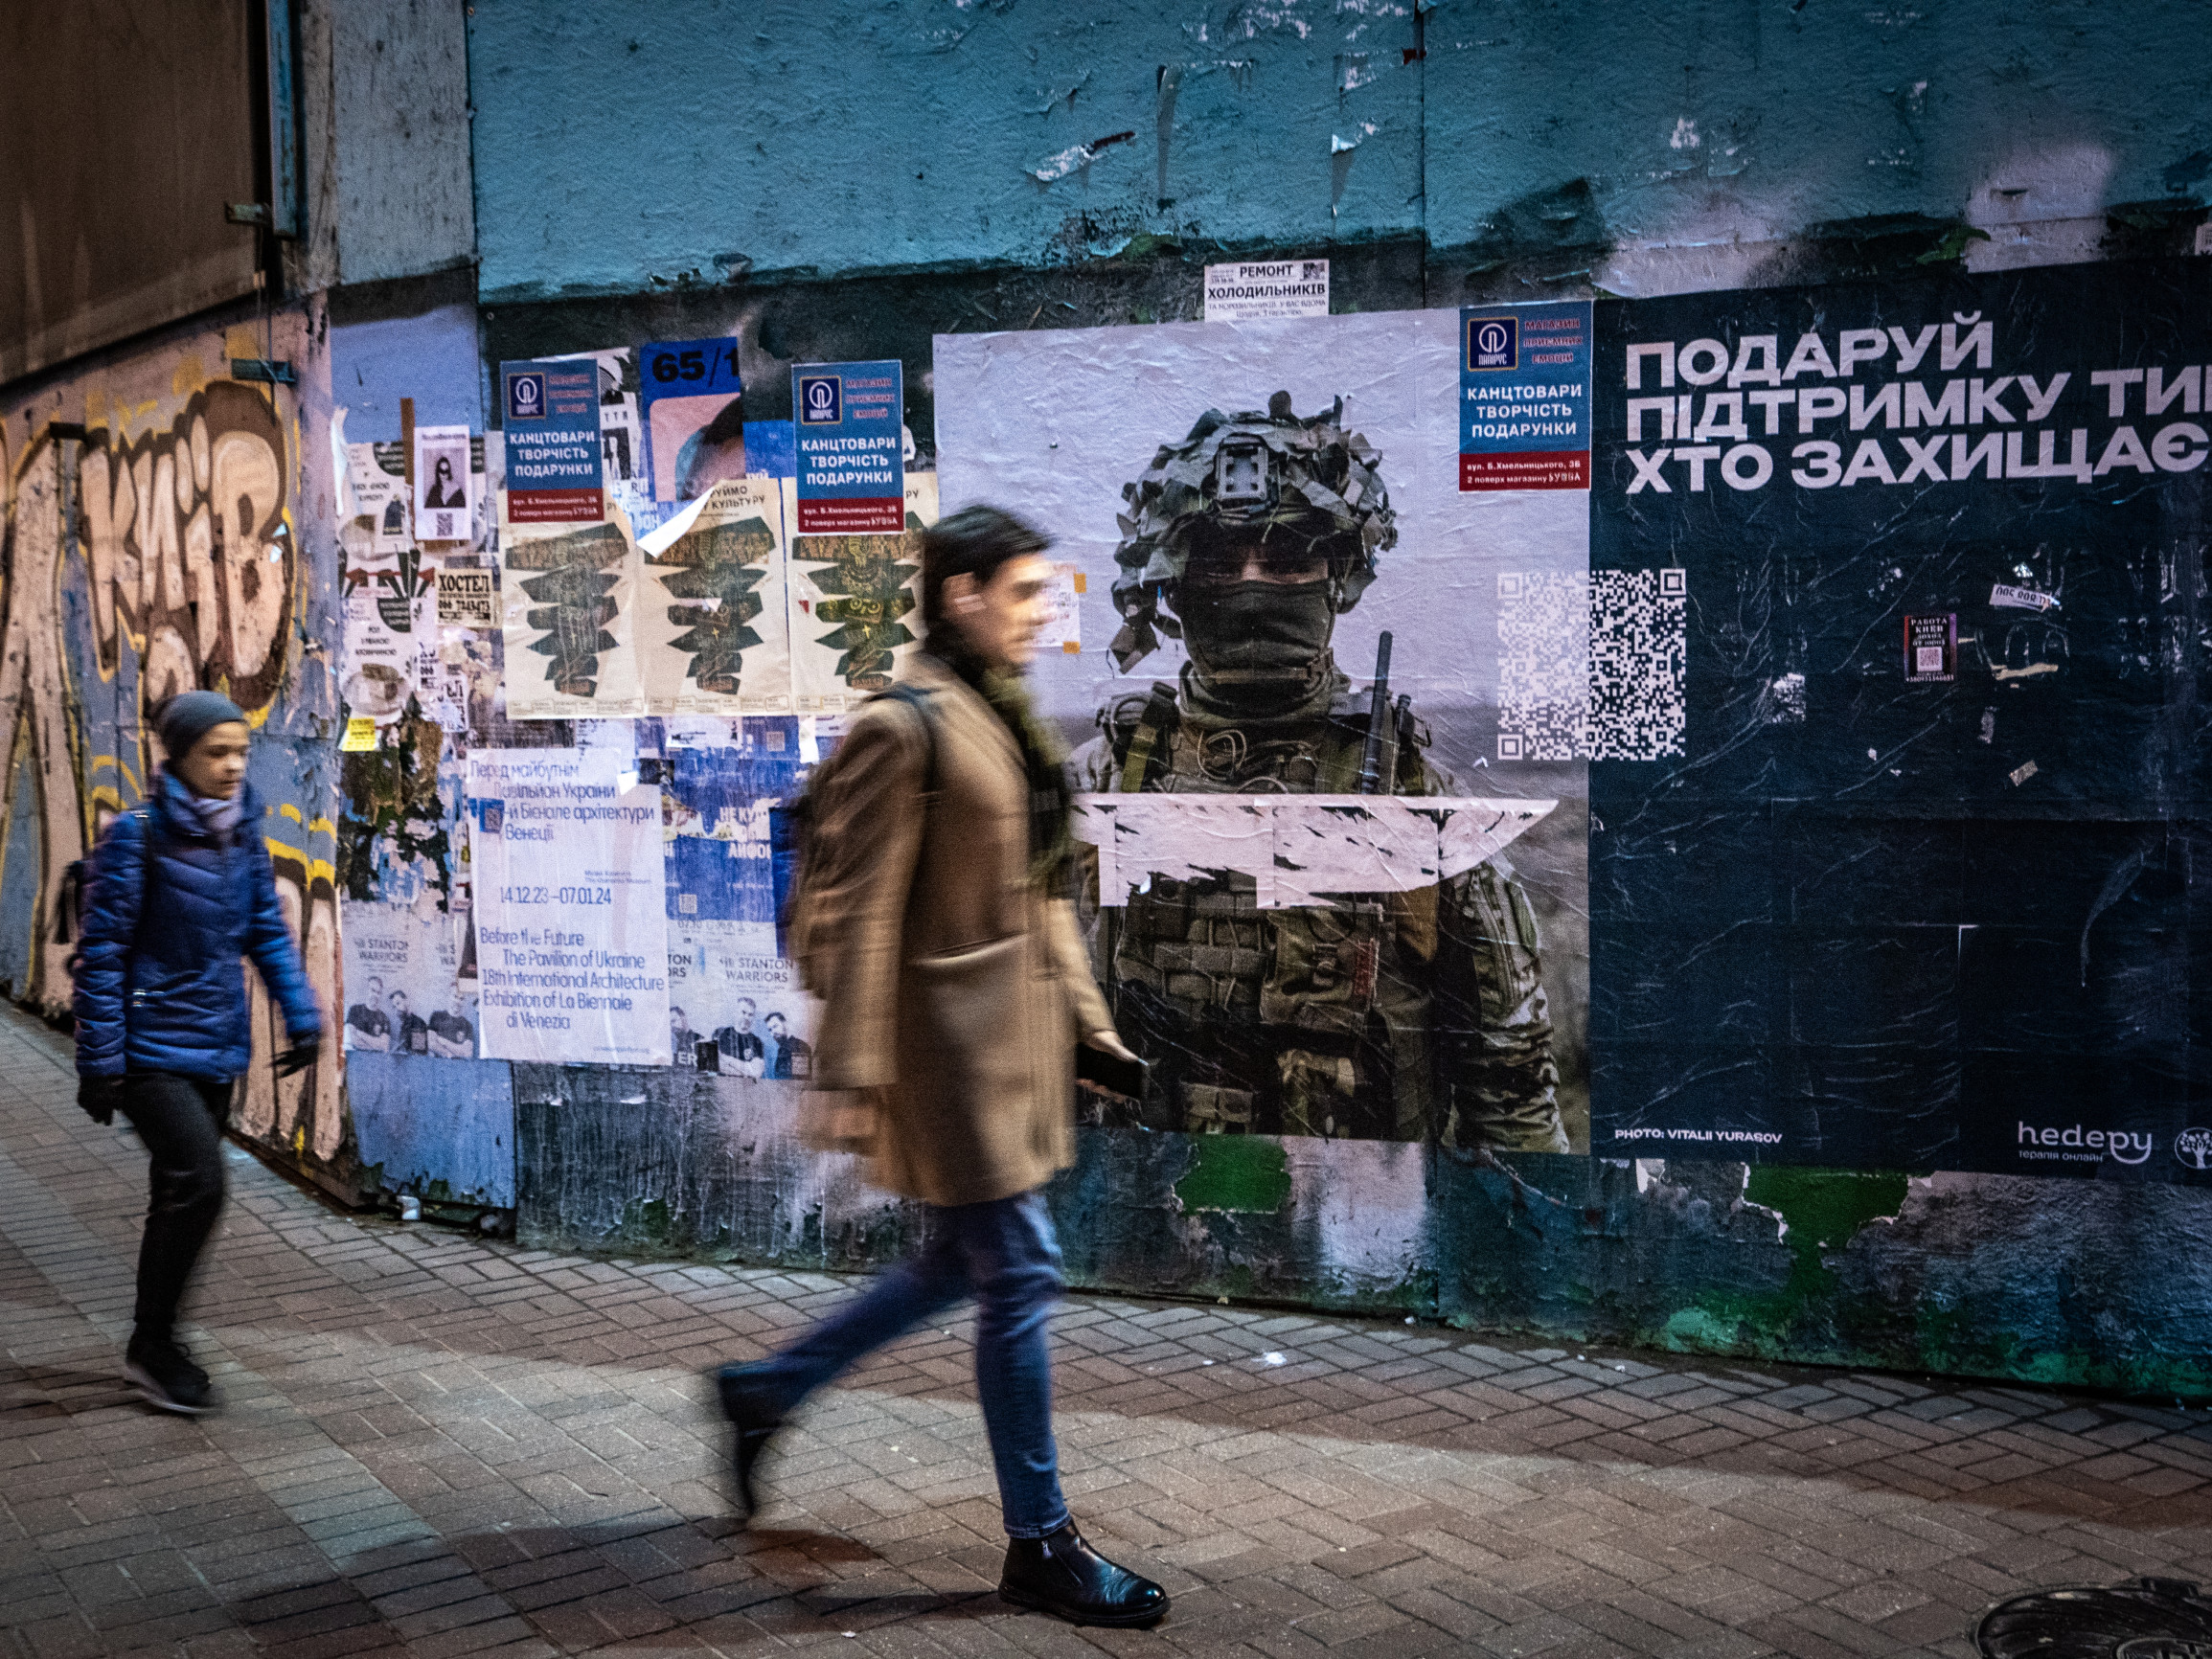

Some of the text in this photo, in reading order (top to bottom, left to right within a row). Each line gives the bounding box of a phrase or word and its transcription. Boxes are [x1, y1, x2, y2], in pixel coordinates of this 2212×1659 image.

[1240, 264, 1293, 278] РЕМОНТ
[1208, 284, 1326, 299] ХОЛОДИЛЬНИКІВ
[1627, 309, 1994, 390] ПОДАРУЙ
[652, 347, 740, 387] 65/1
[1468, 384, 1582, 401] КАНЦТОВАРИ
[1476, 404, 1572, 419] ТВОРЧІСТЬ
[1627, 364, 2212, 443] ПІДТРИМКУ ТИ
[510, 431, 595, 445] КАНЦТОВАРИ
[1471, 421, 1577, 439] ПОДАРУНКИ
[802, 437, 896, 452] КАНЦТОВАРИ
[517, 447, 589, 461] ТВОРЧІСТЬ
[810, 454, 889, 468] ТВОРЧІСТЬ
[1626, 421, 2209, 494] ХТО ЗАХИЩАЄ
[514, 464, 593, 478] ПОДАРУНКИ
[1467, 463, 1485, 472] вул.
[806, 471, 893, 486] ПОДАРУНКИ
[1474, 475, 1505, 485] поверх
[1506, 474, 1547, 484] магазину
[712, 495, 765, 510] КУЛЬТУРУ
[439, 575, 490, 592] ХОСТЕЛ
[563, 782, 615, 803] України
[574, 804, 654, 824] архітектури
[480, 927, 518, 945] Before
[543, 928, 584, 946] Future
[503, 948, 646, 969] The Pavilion of Ukraine
[738, 957, 794, 970] STANTON
[482, 968, 665, 990] 18th International Architecture
[725, 969, 788, 983] WARRIORS
[483, 989, 632, 1011] Exhibition of La Biennale
[506, 1011, 571, 1030] di Venezia
[1614, 1128, 1783, 1144] PHOTO: VITALII YURASOV
[2018, 1121, 2152, 1164] hedepy
